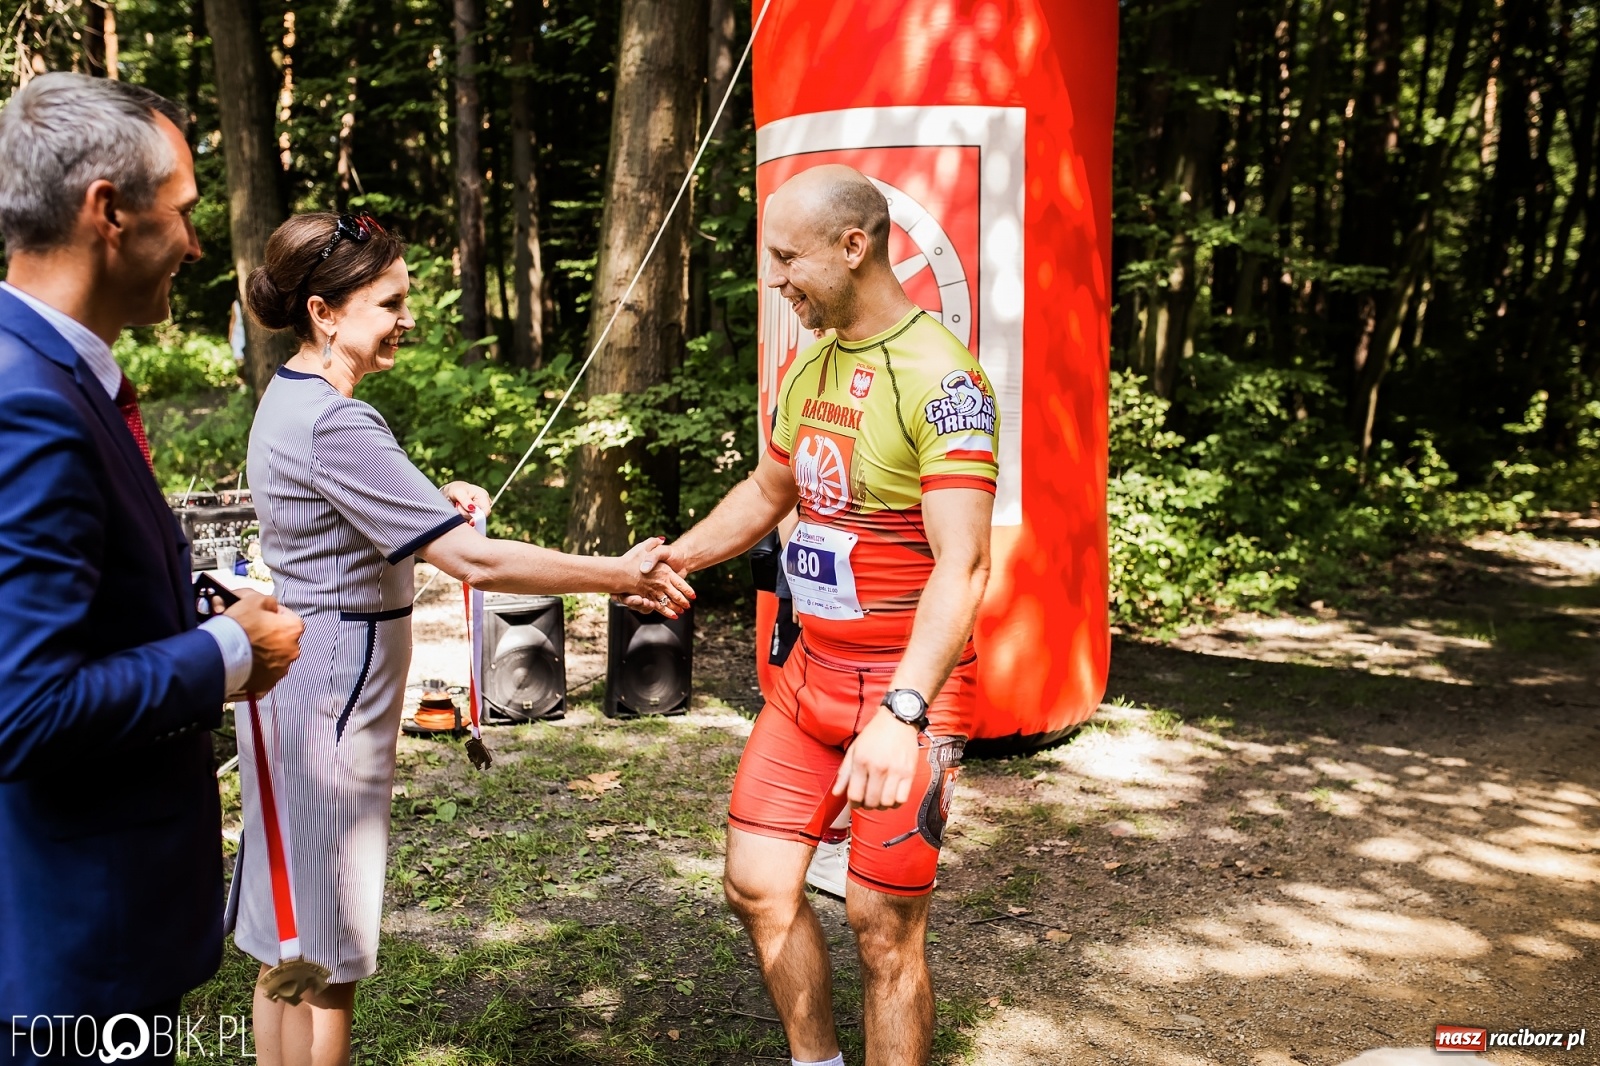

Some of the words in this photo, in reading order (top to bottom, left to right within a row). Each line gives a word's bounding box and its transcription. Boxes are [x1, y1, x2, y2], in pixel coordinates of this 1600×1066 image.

[856, 362, 877, 372] POLSKA
[935, 410, 995, 437] TRENING
[797, 548, 820, 578] 80
